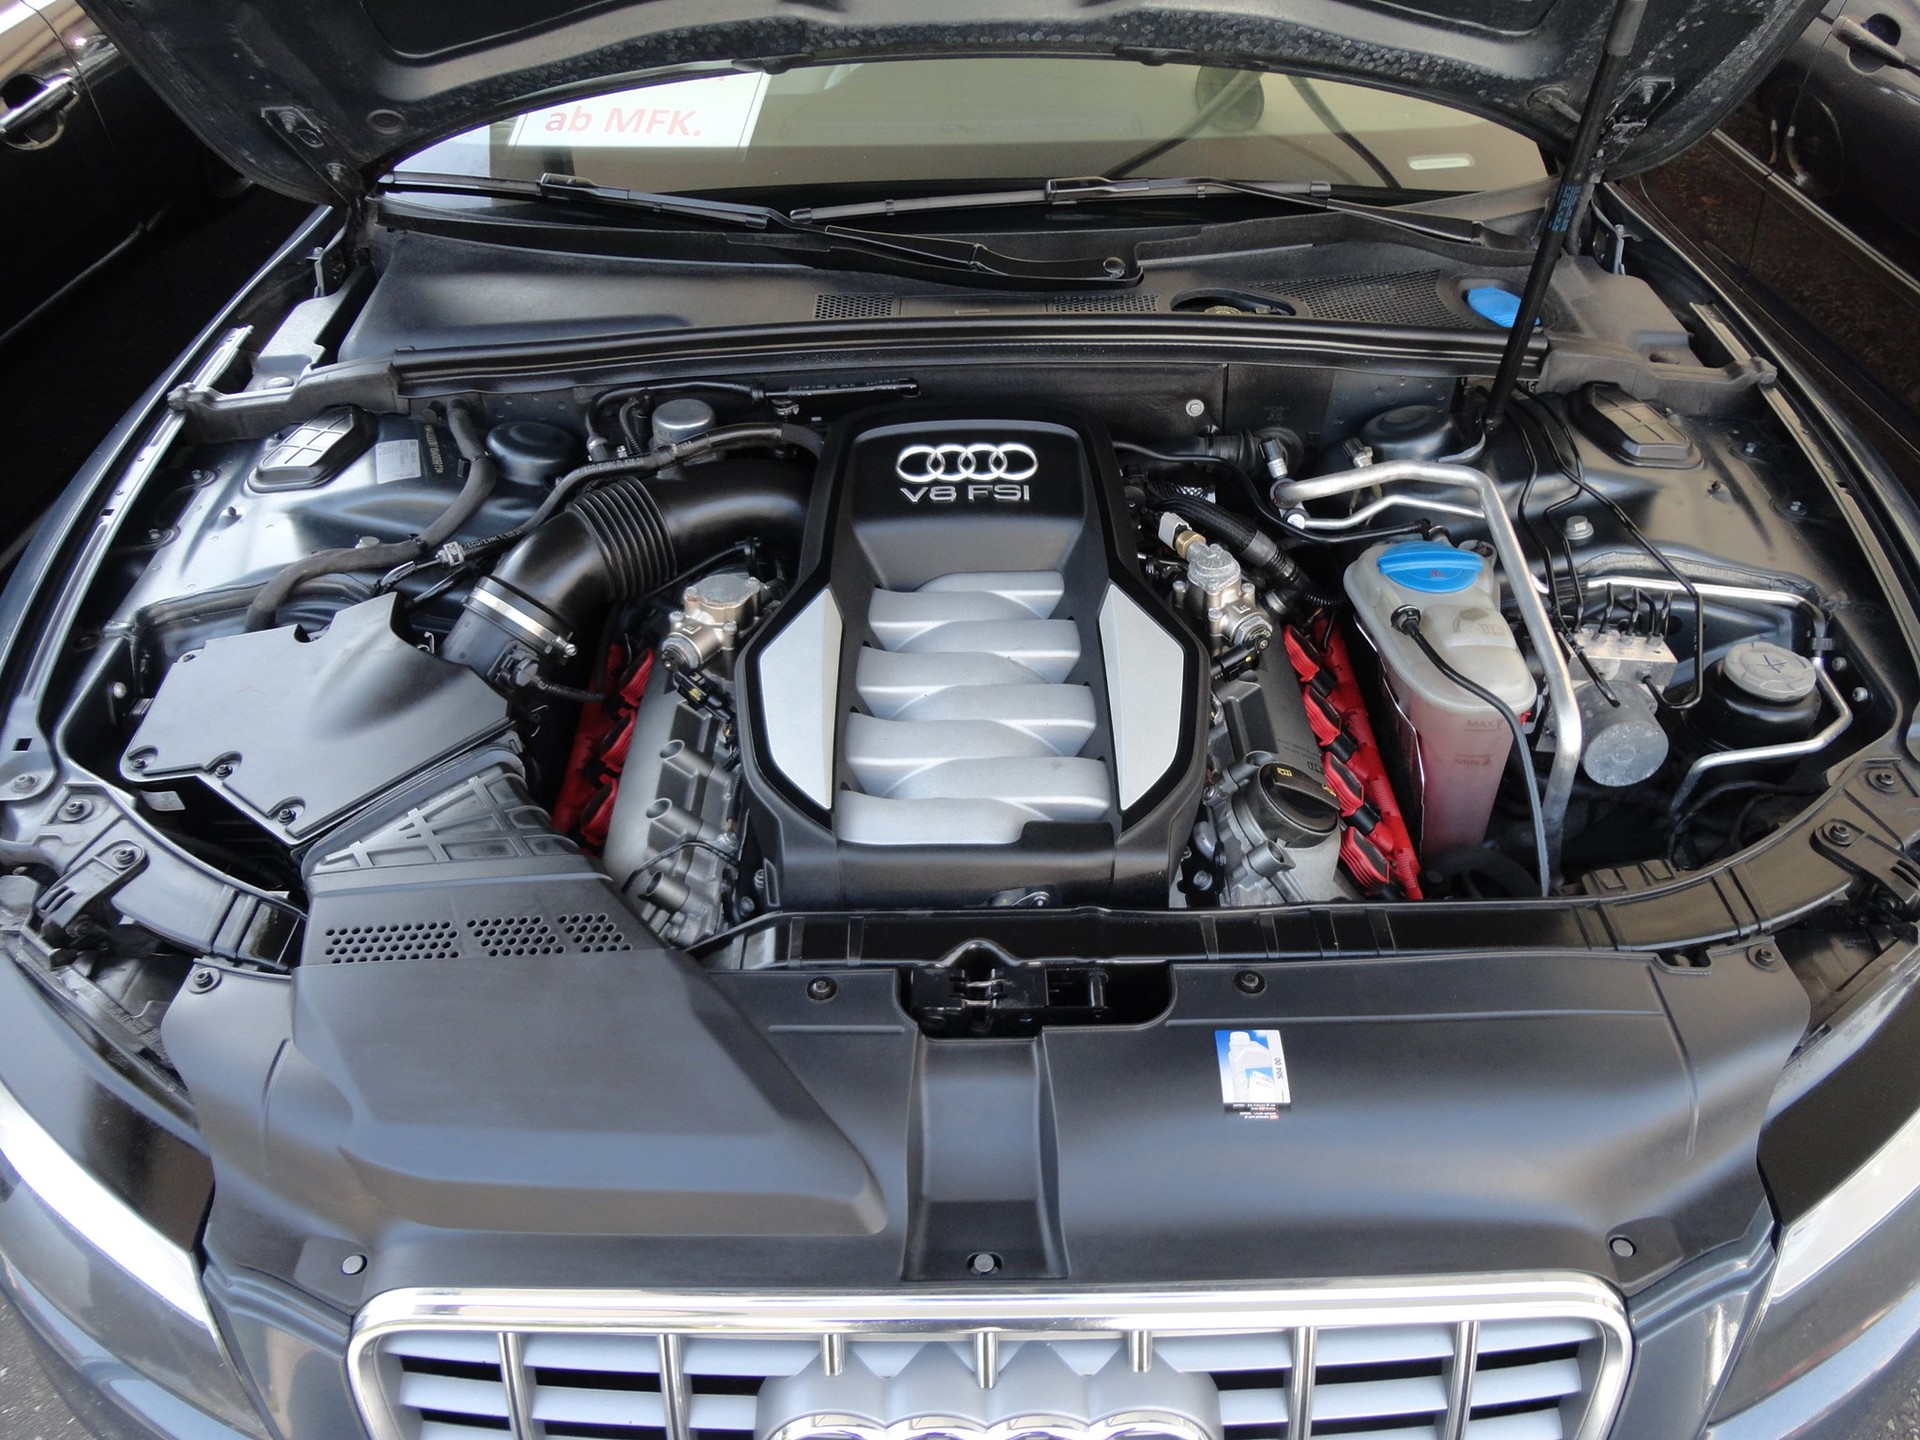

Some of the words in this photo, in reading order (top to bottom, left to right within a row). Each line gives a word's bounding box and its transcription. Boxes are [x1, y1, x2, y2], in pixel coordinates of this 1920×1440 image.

[545, 105, 593, 132] ab
[603, 107, 702, 137] MFK.
[900, 485, 957, 504] V8
[967, 484, 1030, 502] FSI
